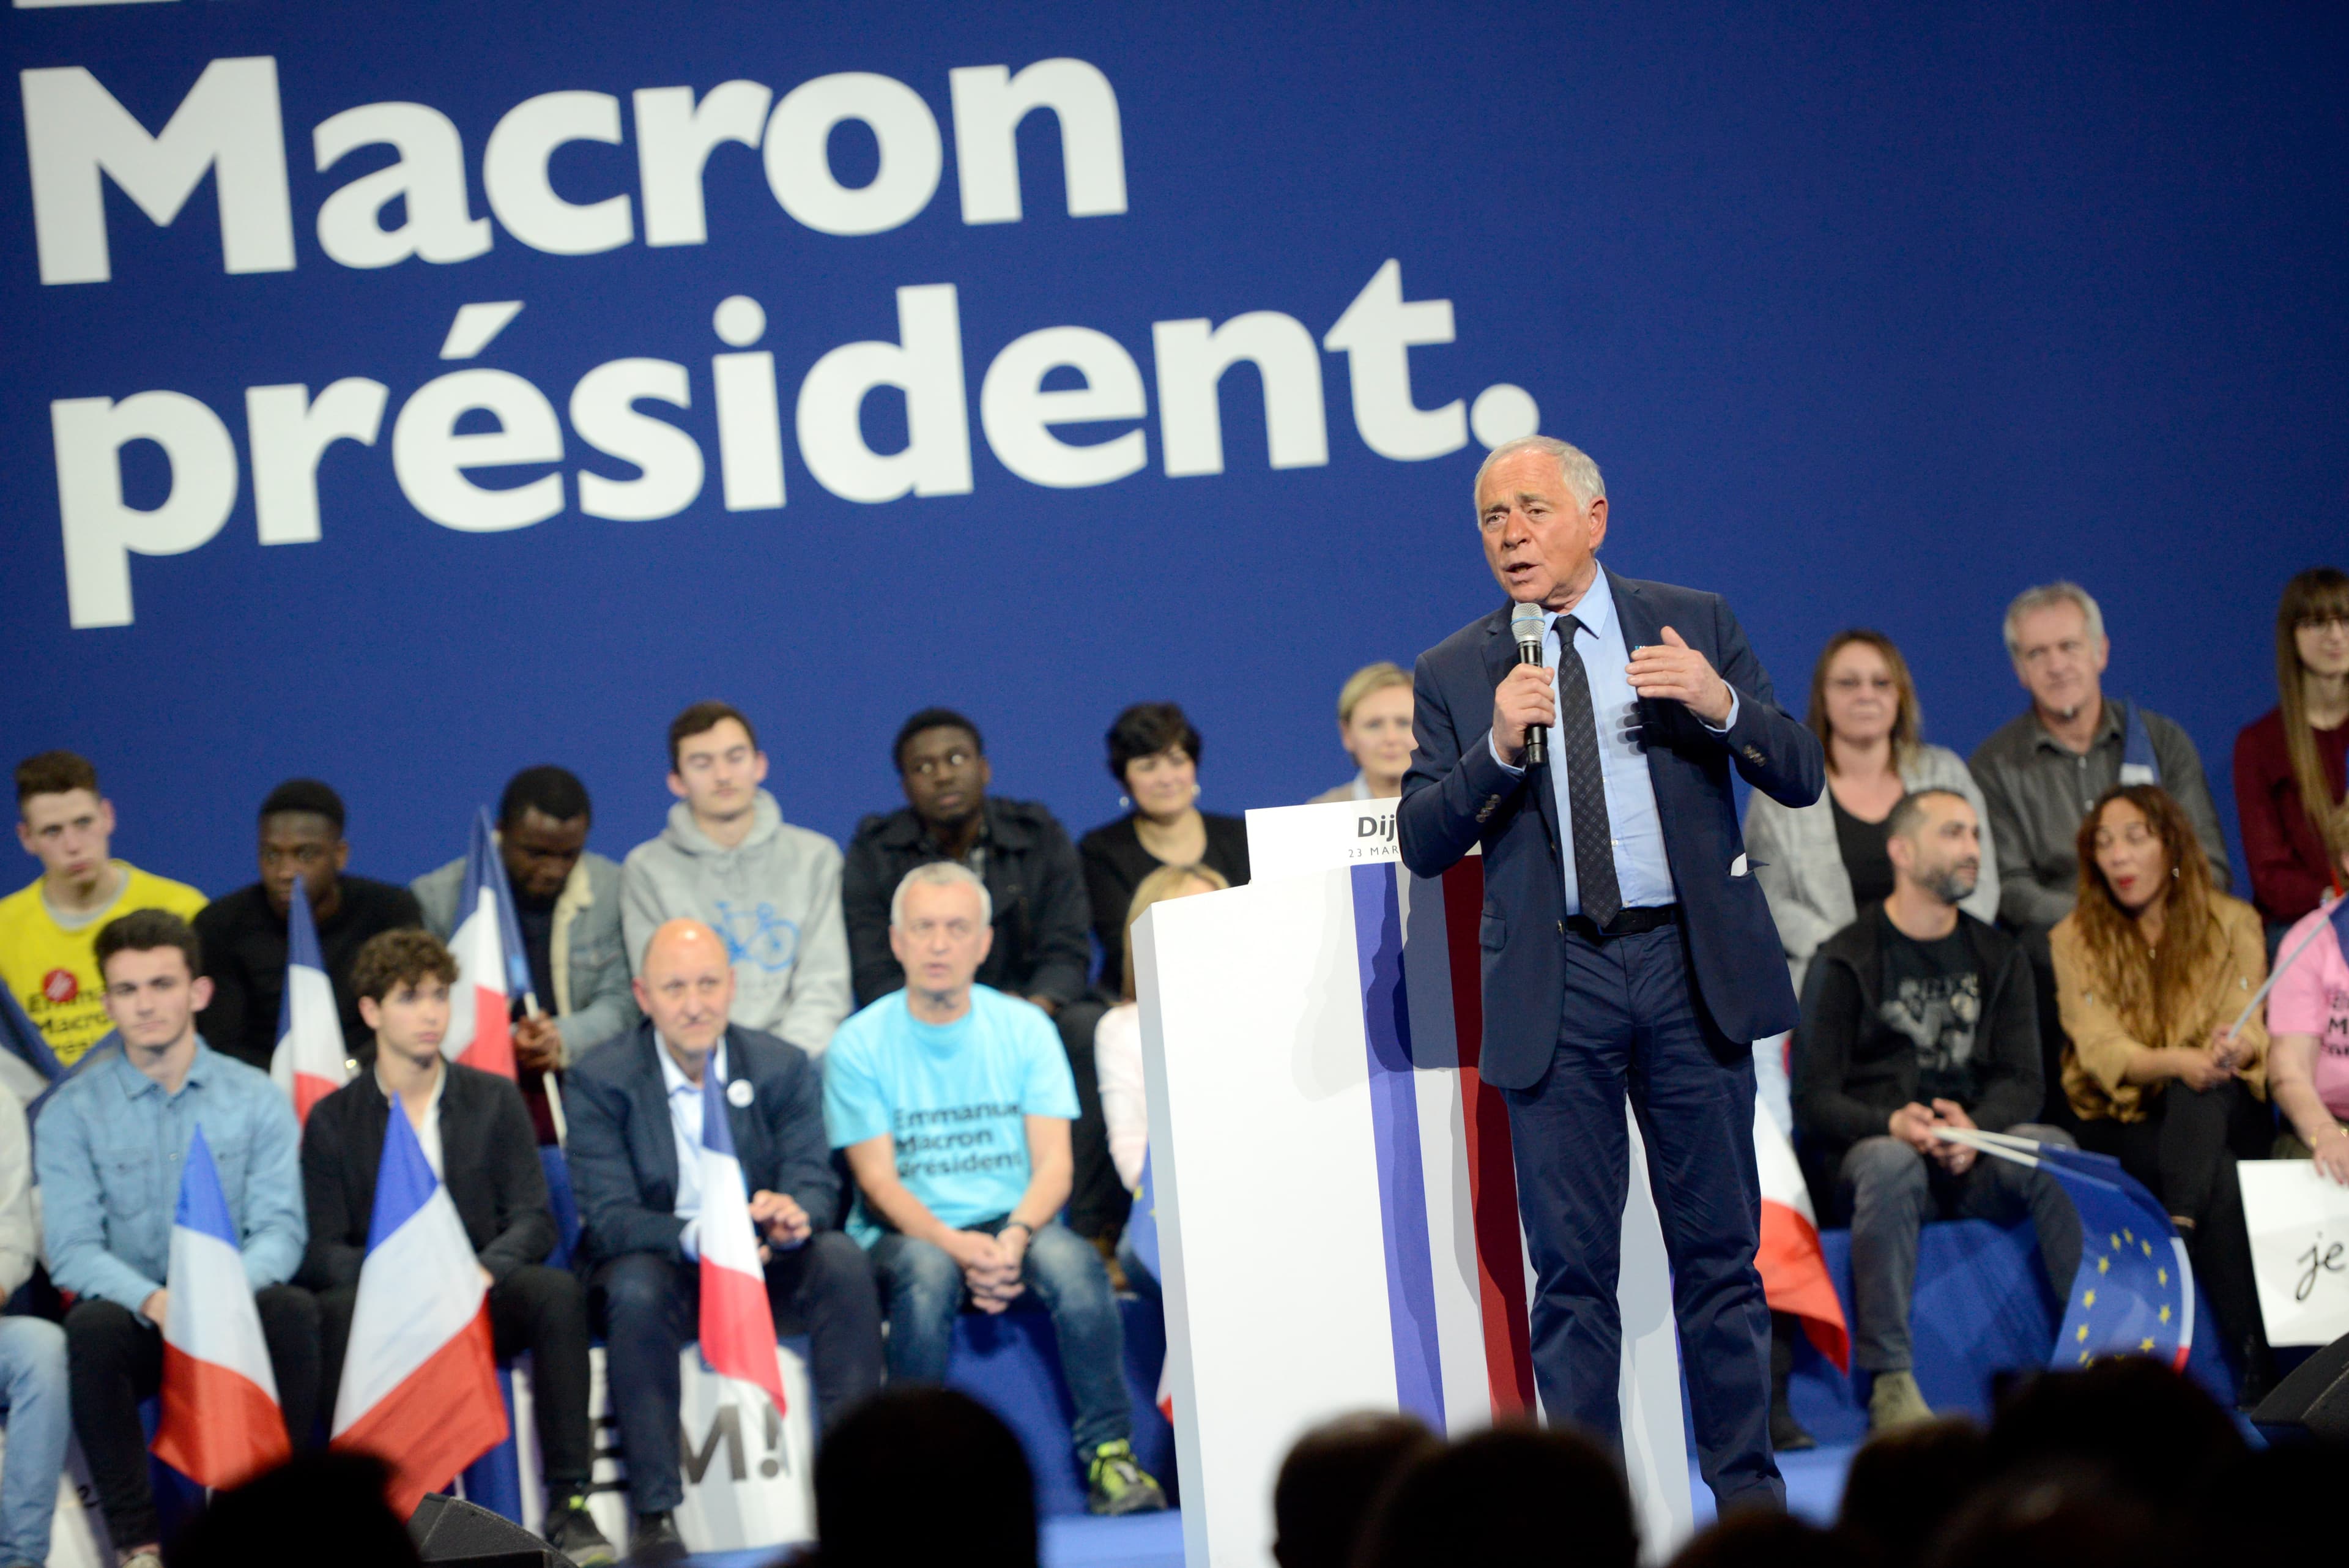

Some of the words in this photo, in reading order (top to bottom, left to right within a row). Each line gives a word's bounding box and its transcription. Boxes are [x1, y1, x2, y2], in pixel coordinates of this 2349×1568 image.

[20, 56, 1128, 286] Macron
[51, 258, 1540, 629] président.
[1348, 849, 1362, 858] 23
[1370, 845, 1399, 856] MAR
[1357, 814, 1395, 842] Dij
[895, 1129, 993, 1158] Macron
[2296, 1230, 2347, 1301] je
